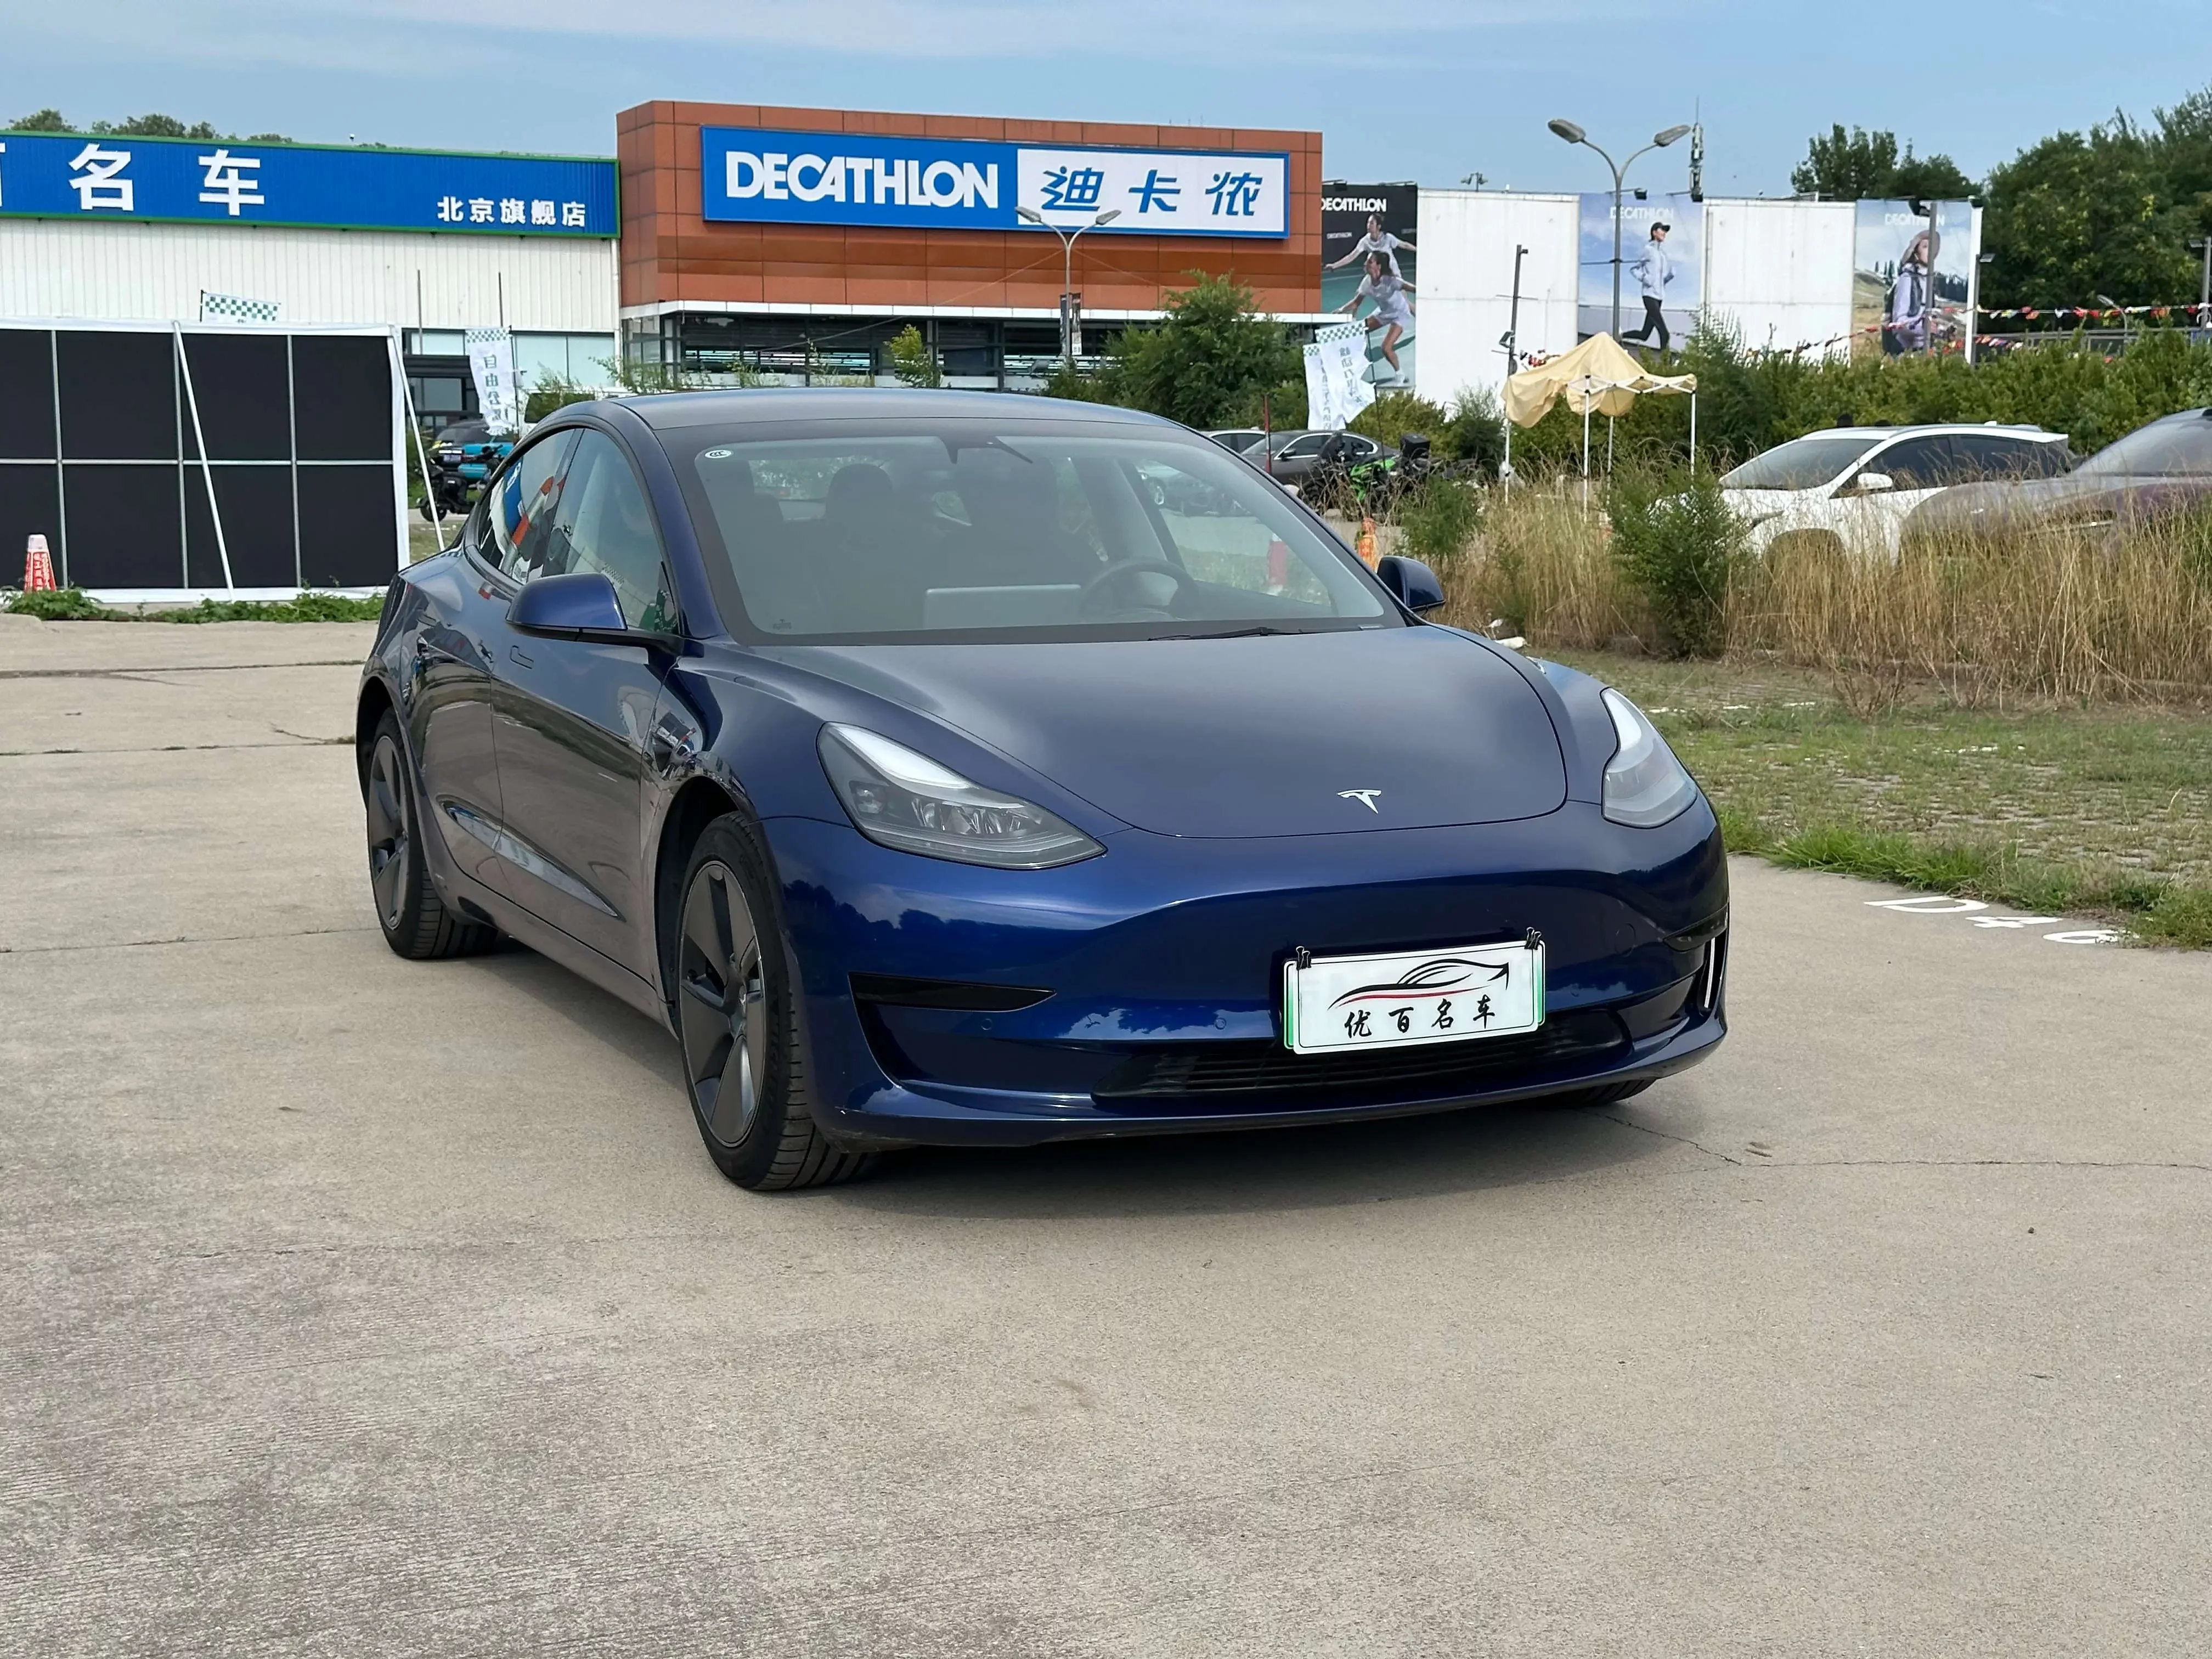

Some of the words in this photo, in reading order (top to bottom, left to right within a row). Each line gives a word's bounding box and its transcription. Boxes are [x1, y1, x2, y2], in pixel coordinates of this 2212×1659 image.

[0, 142, 266, 216] 名车
[726, 151, 998, 208] DECATHLON
[1040, 166, 1262, 216] 迪卡侬
[437, 196, 585, 227] 北京旗舰店
[1344, 994, 1495, 1039] 优百名车
